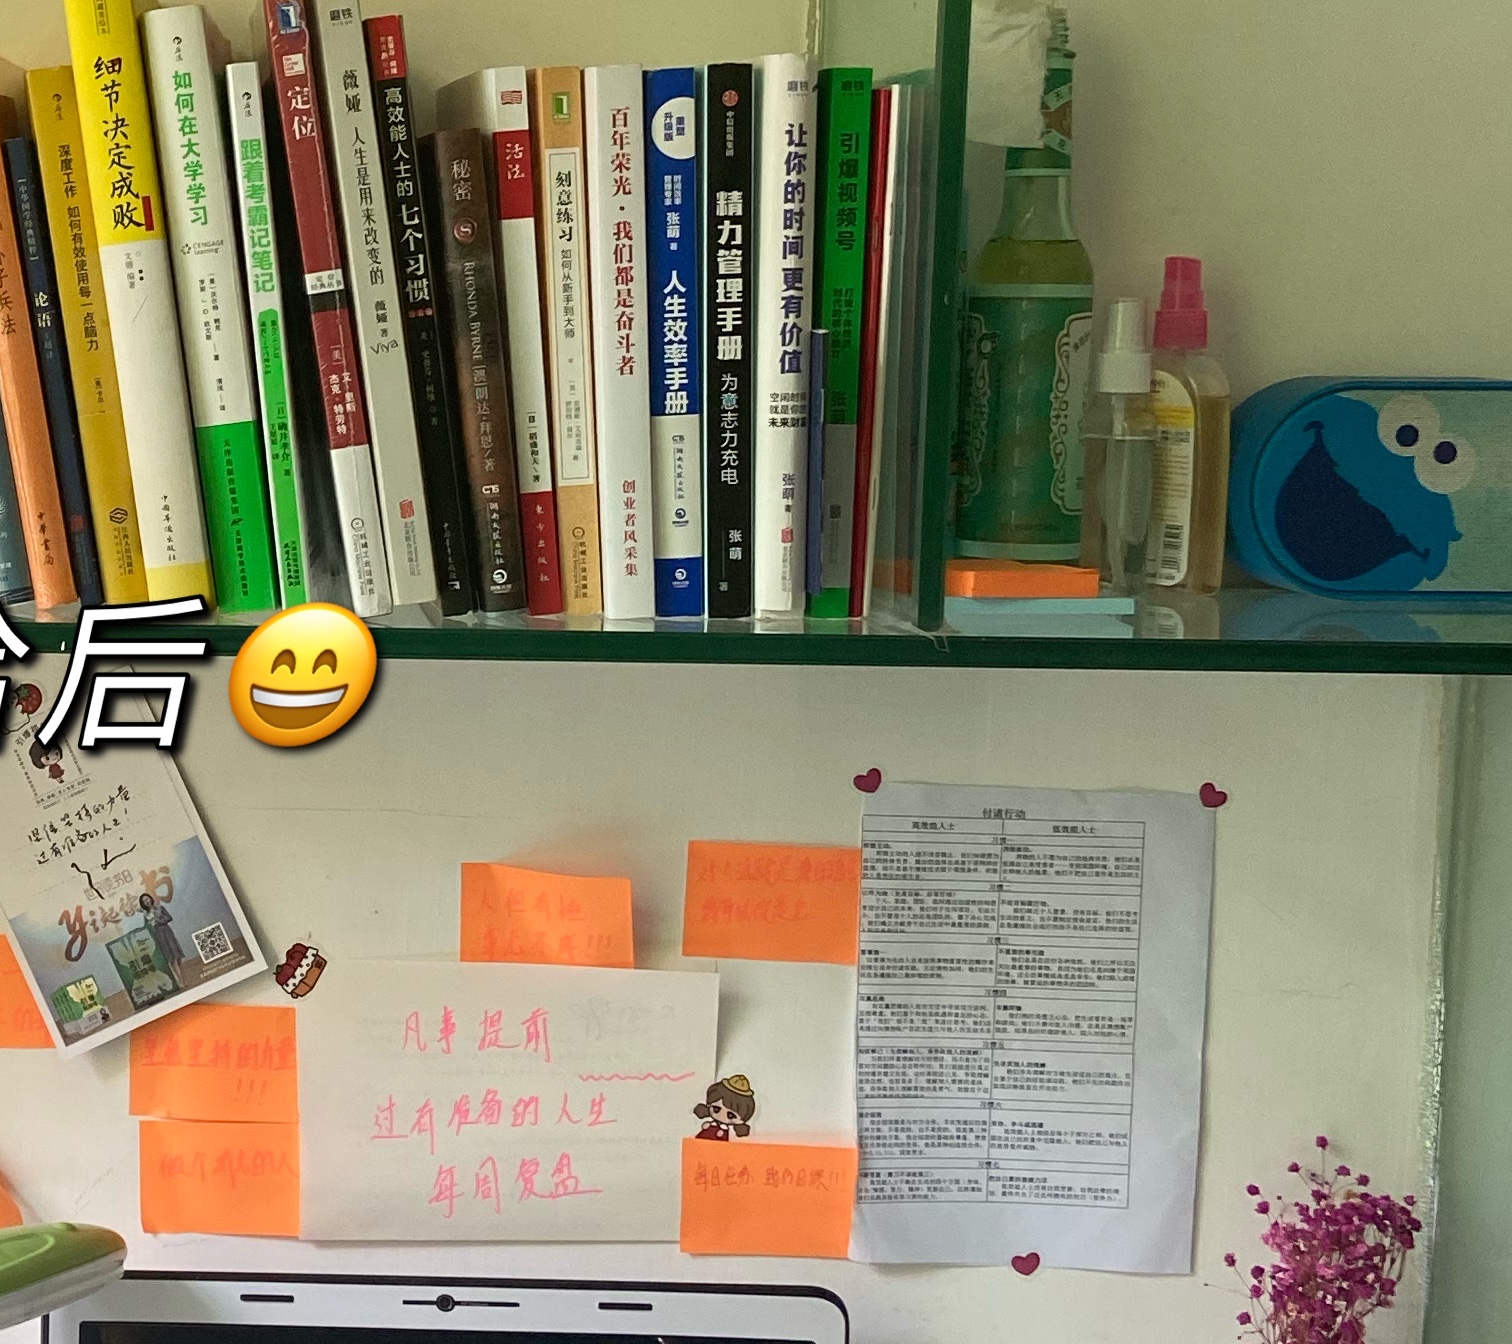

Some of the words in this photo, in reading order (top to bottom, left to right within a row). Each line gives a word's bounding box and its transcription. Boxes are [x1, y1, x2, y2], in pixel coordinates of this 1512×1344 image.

[93, 55, 145, 231] 细节决定成败
[172, 70, 209, 226] 如何在大学学习
[287, 86, 316, 142] 定位
[504, 143, 525, 181] 活法
[58, 144, 79, 199] 深度工作
[240, 137, 275, 294] 跟着考霸记笔记
[351, 127, 384, 286] 人生是用来改变的
[384, 86, 431, 303] 高效能人士的七个习惯
[451, 159, 472, 202] 秘密
[555, 170, 575, 243] 刻意练习
[835, 132, 861, 251] 引爆视频号
[66, 206, 100, 353] 如何有效使用每一点脑力
[560, 248, 576, 340] 如何从新手到大师
[715, 190, 744, 361] 精力管理手册
[779, 122, 808, 375] 让你的时间更有价值
[34, 291, 55, 329] 论语
[464, 259, 478, 319] RHONDA
[471, 322, 483, 359] BYRNE
[663, 269, 689, 414] 人生效率手册
[719, 372, 740, 486] 为意志力充电
[622, 478, 639, 577] 创业者风采集
[728, 528, 744, 561] 张萌
[401, 1005, 553, 1063] 凡事提前
[370, 1092, 619, 1154] 过有准备的人生
[428, 1152, 604, 1219] 每周复盘
